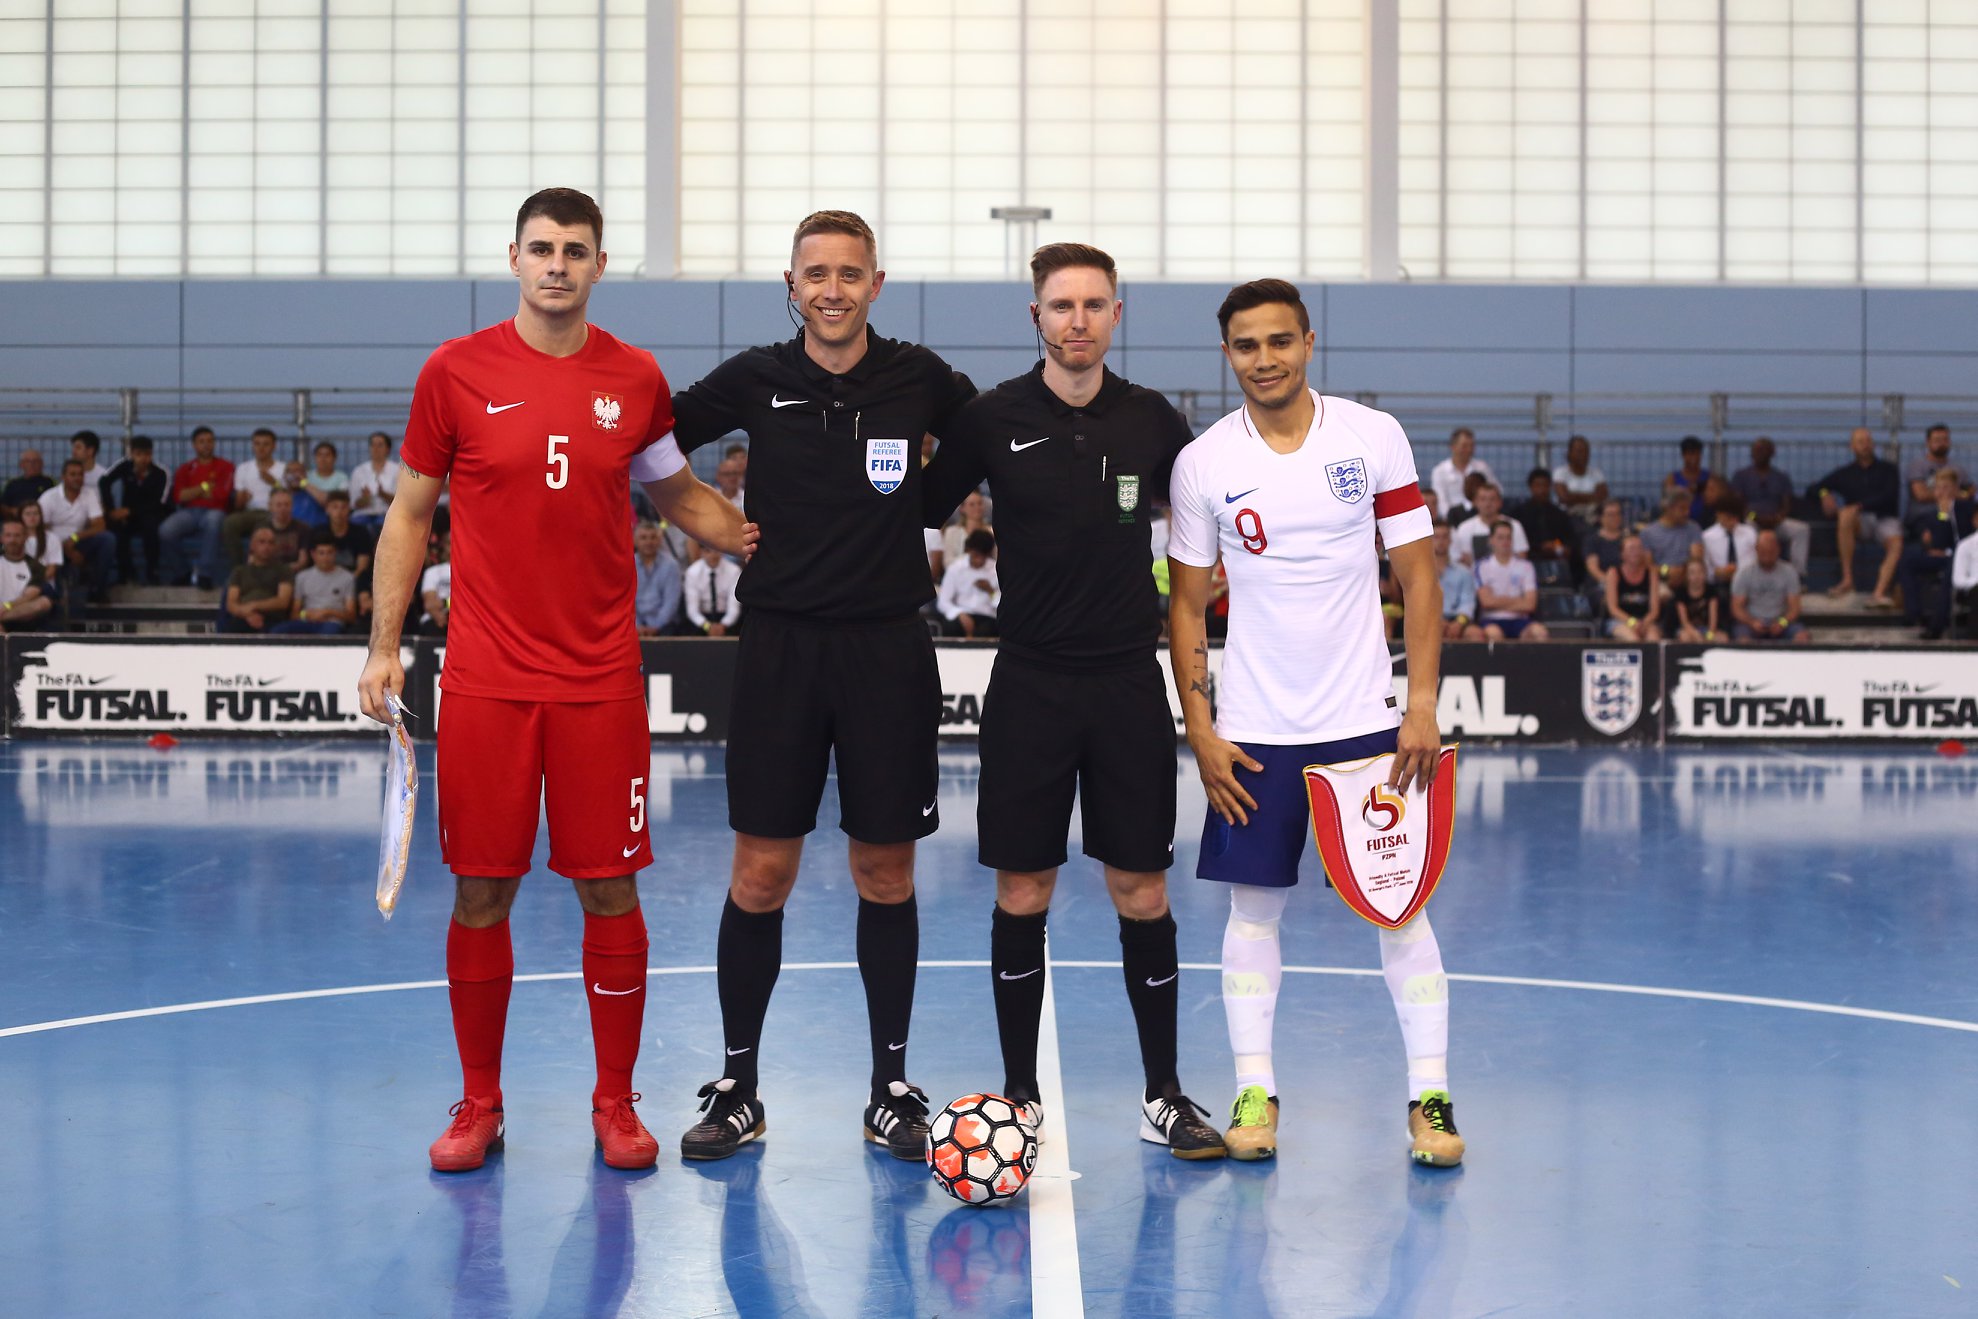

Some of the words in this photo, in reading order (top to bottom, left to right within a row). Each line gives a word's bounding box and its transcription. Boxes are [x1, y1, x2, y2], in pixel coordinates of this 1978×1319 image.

[546, 434, 570, 490] 5
[871, 459, 902, 471] FIFA
[1235, 508, 1268, 555] 9
[630, 777, 645, 833] 5
[1366, 833, 1410, 852] FUTSAL
